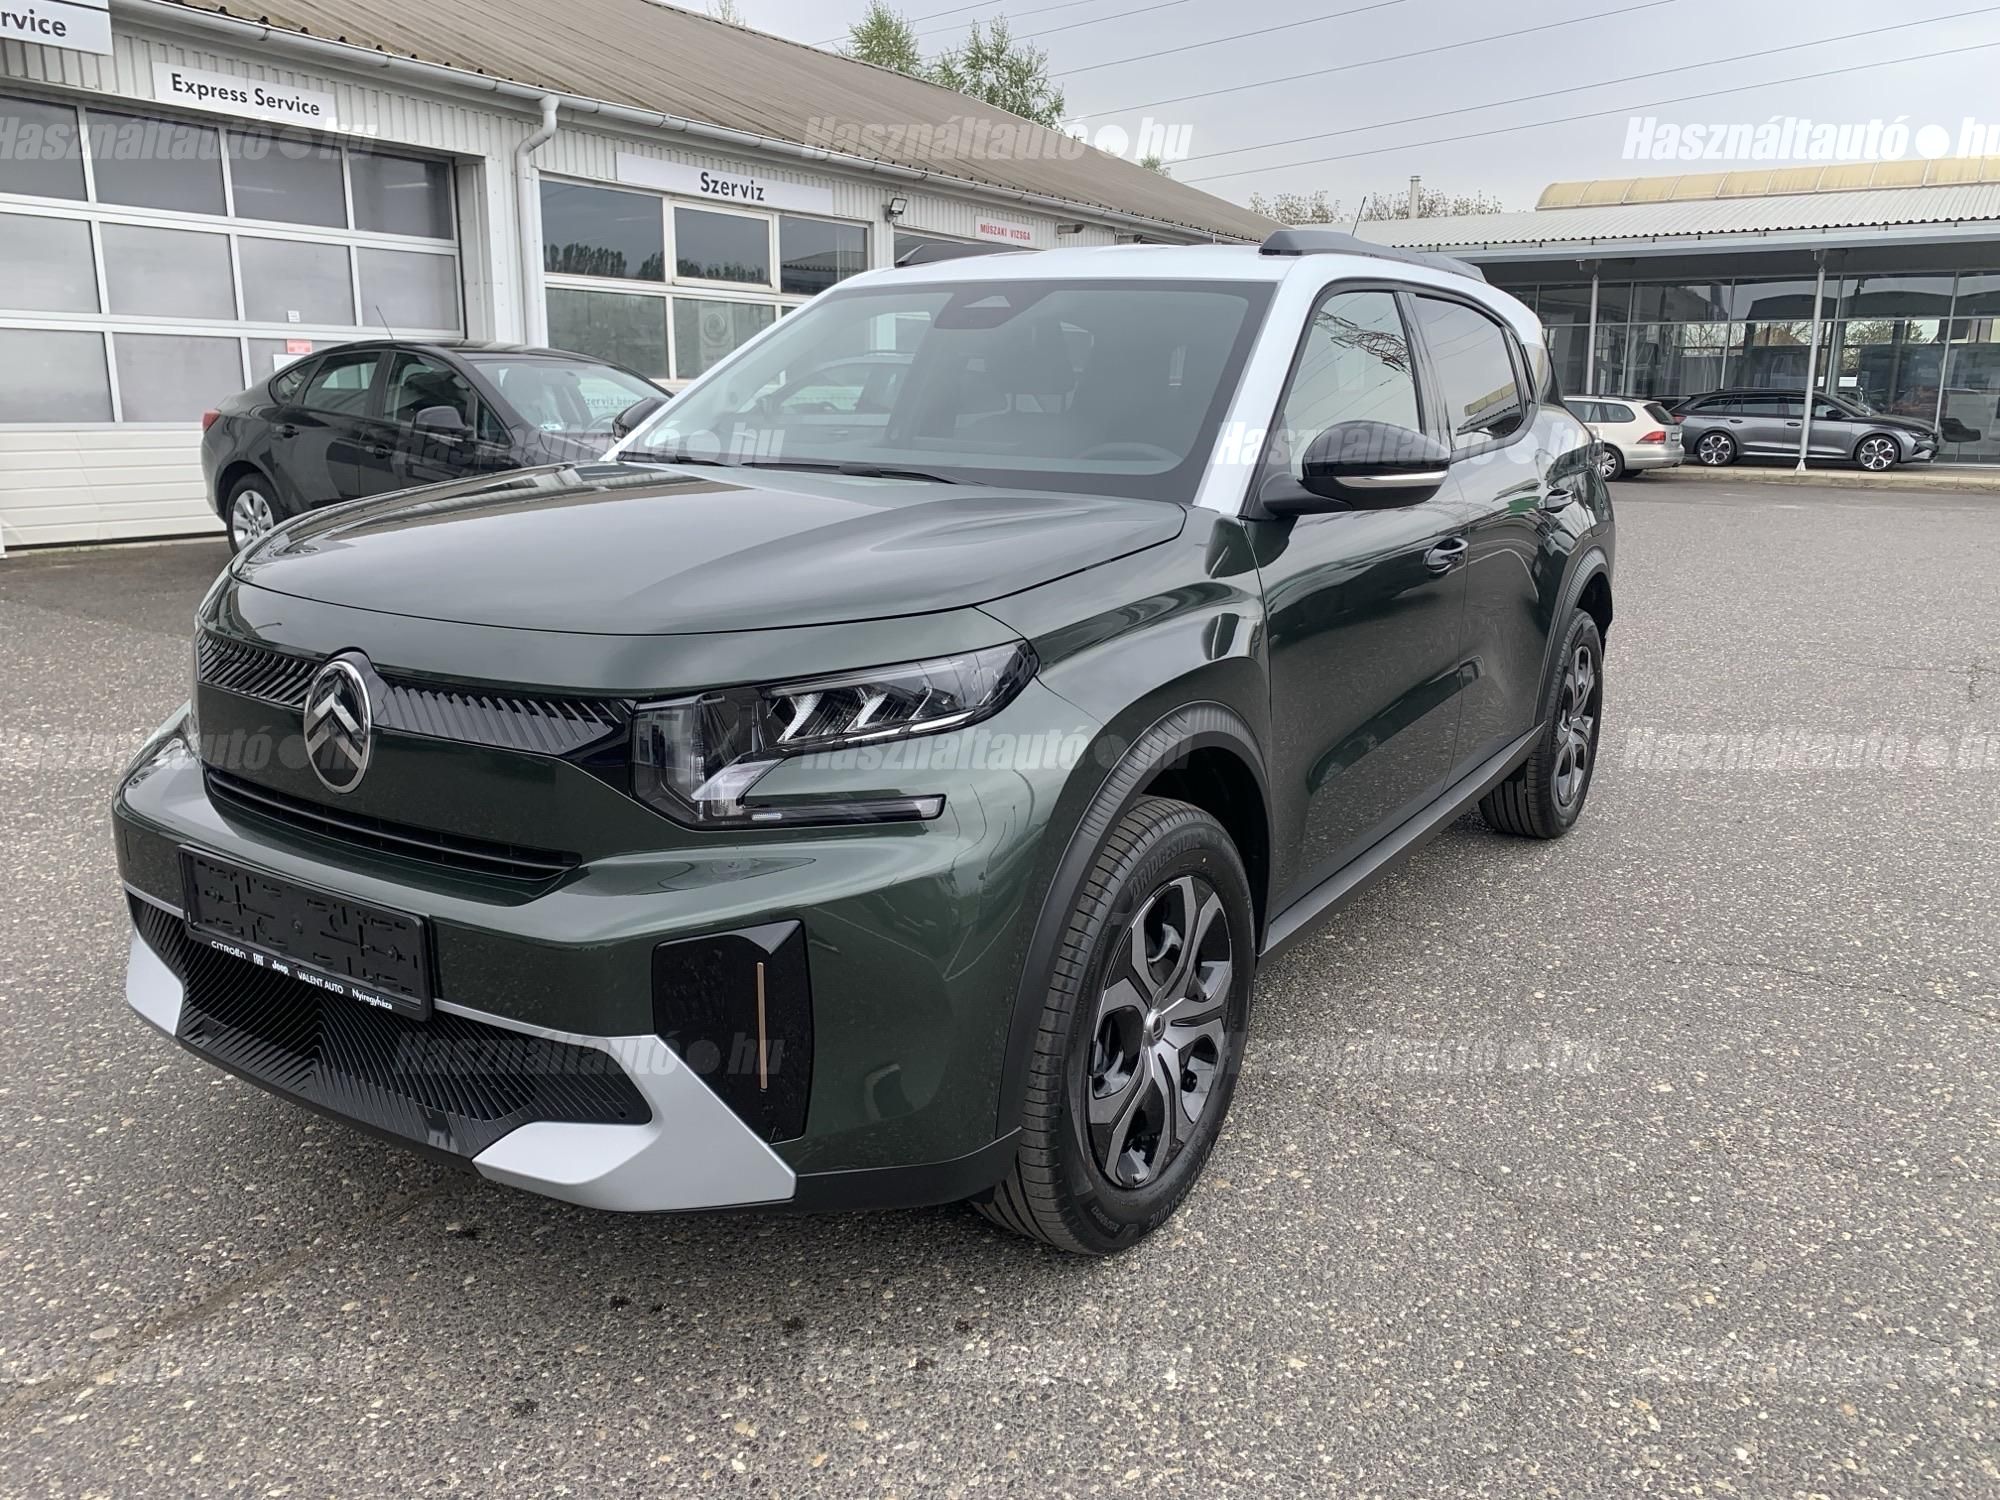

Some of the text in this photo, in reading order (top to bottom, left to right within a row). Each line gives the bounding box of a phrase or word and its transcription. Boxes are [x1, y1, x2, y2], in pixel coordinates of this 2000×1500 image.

[1, 9, 67, 37] rvice
[171, 73, 320, 116] Express Service
[700, 171, 765, 202] Szerviz
[1009, 229, 1031, 241] VIZSGA
[271, 960, 290, 977] Jeep
[296, 970, 323, 988] VALENT
[324, 980, 344, 995] AUTO
